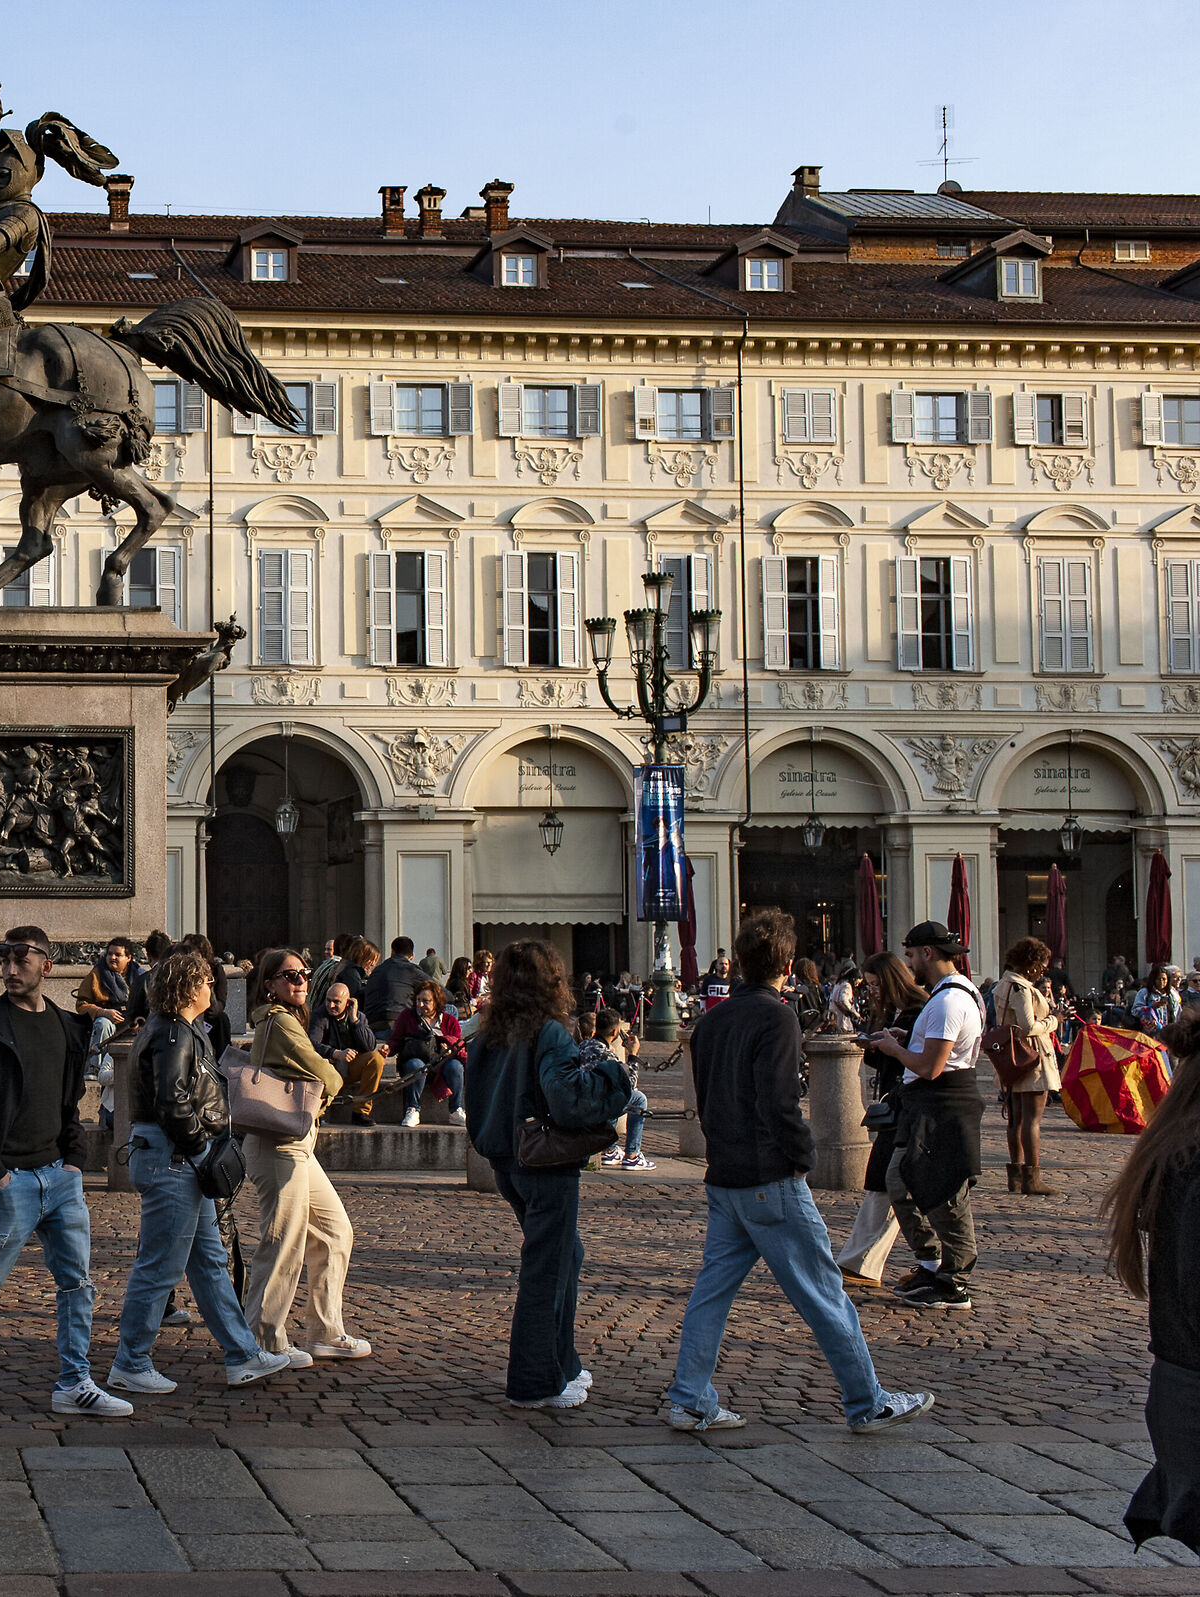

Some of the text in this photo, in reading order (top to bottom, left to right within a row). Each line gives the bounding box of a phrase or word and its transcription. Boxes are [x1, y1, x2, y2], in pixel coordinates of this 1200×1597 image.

[518, 763, 576, 776] sinatra
[779, 768, 836, 782] sinatra
[709, 986, 729, 996] FIL
